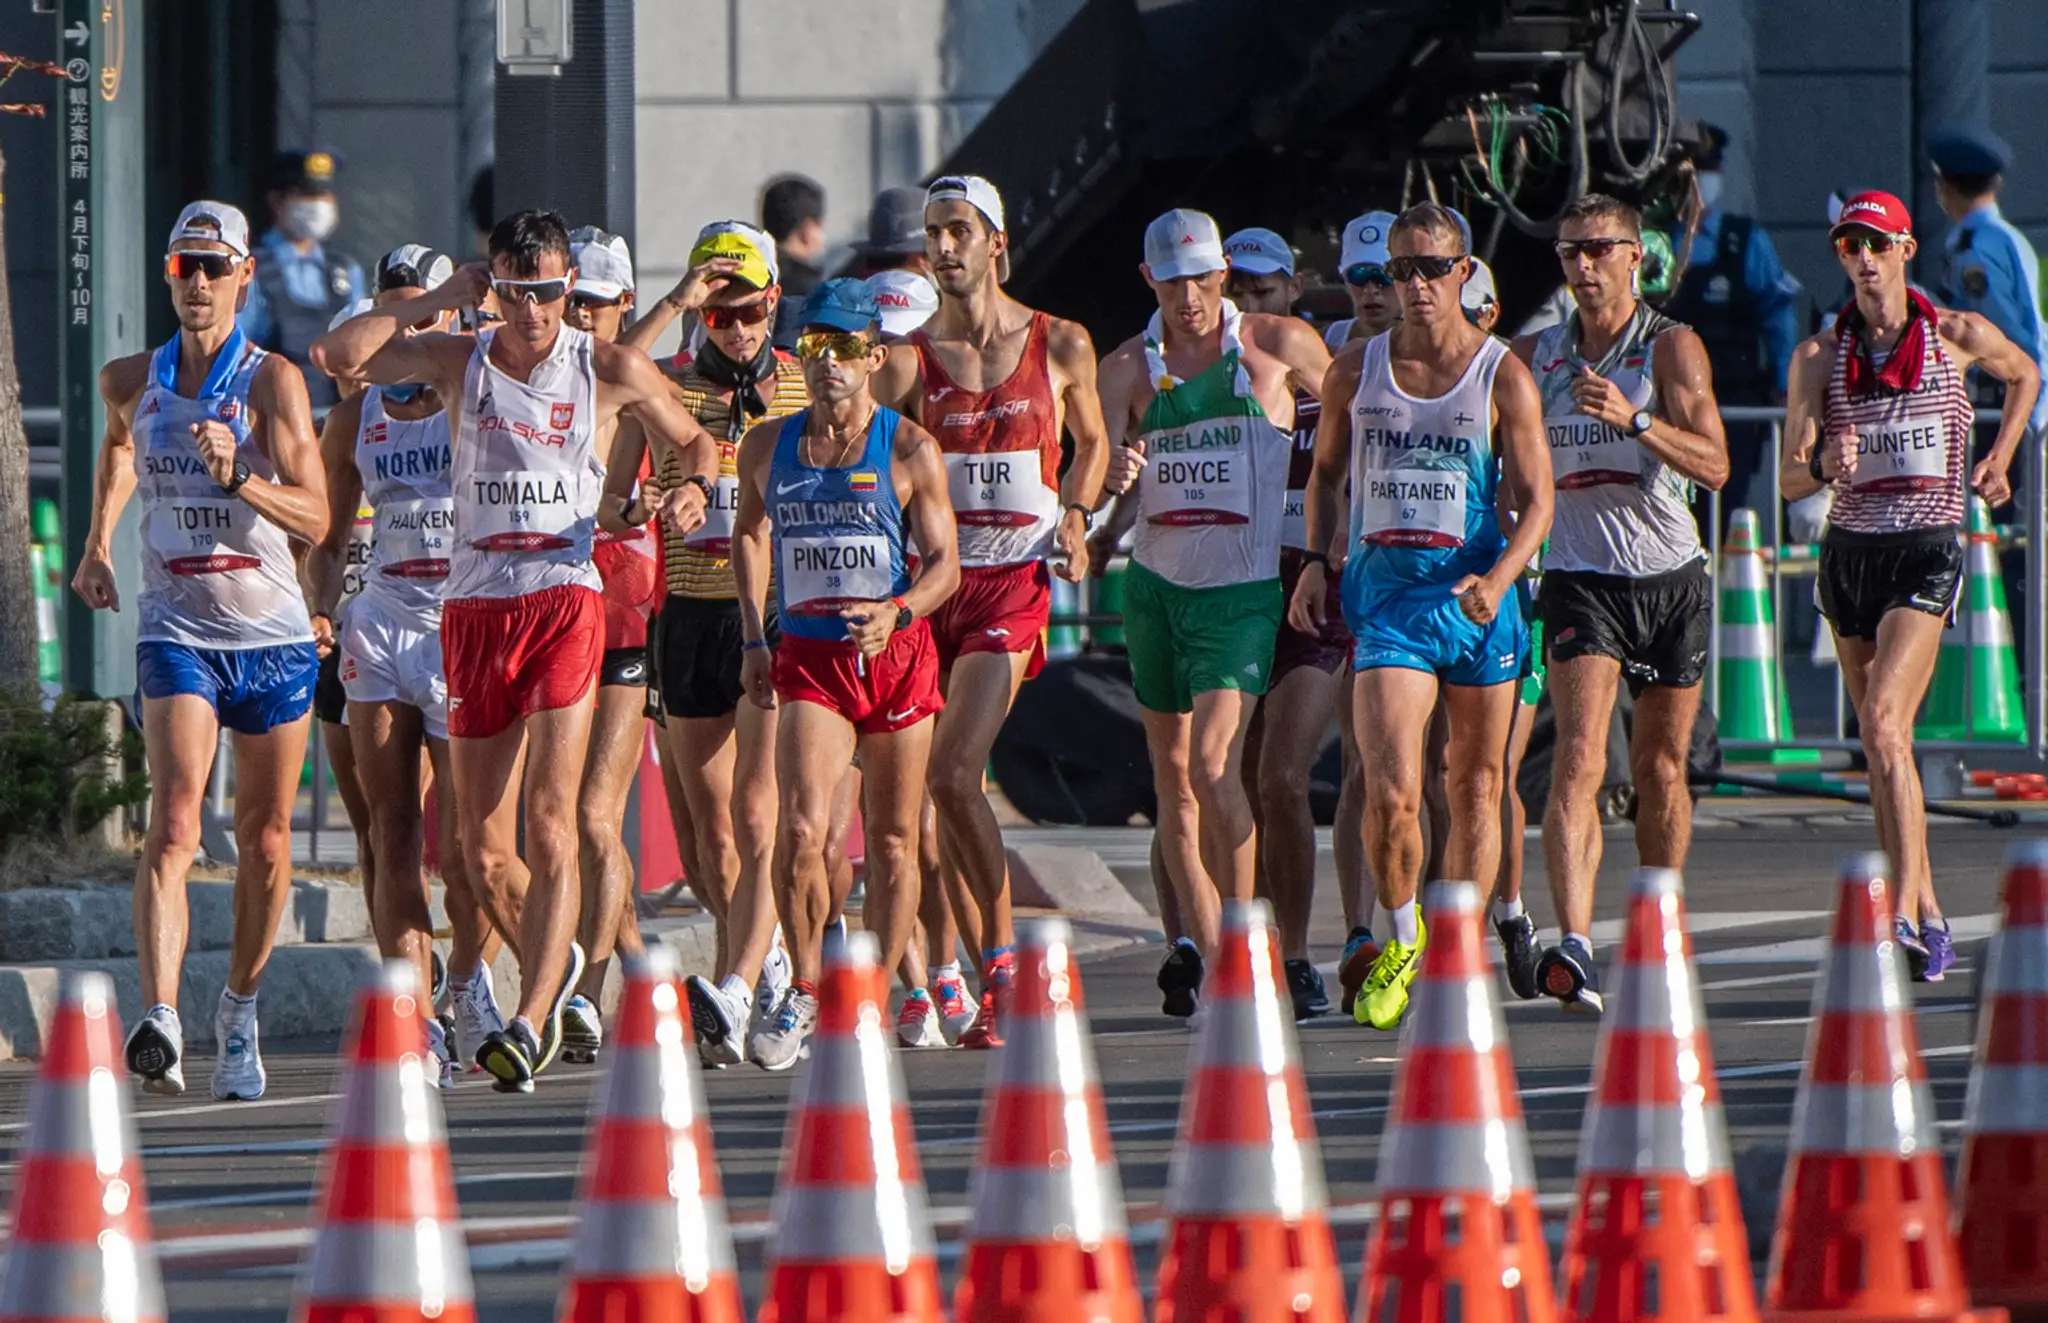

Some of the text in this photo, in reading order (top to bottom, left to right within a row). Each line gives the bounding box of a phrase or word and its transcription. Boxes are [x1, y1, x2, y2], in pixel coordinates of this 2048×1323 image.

[69, 87, 88, 179] 観光案内所
[1357, 407, 1392, 416] CRAFT
[1365, 428, 1471, 455] FINLAND
[1857, 426, 1936, 455] DUNFEE
[1158, 460, 1231, 484] BOYCE
[1893, 457, 1905, 469] 19
[964, 462, 1011, 485] TUR
[474, 481, 568, 505] TOMALA
[980, 488, 995, 500] 63
[1184, 488, 1205, 500] 105
[1371, 481, 1456, 500] PARTANEN
[173, 506, 231, 530] TOTH
[509, 510, 530, 523] 159
[777, 502, 878, 527] COLOMBIA
[1402, 508, 1417, 519] 67
[191, 534, 213, 548] 170
[419, 537, 442, 549] 148
[794, 545, 876, 571] PINZON
[826, 576, 841, 588] 38
